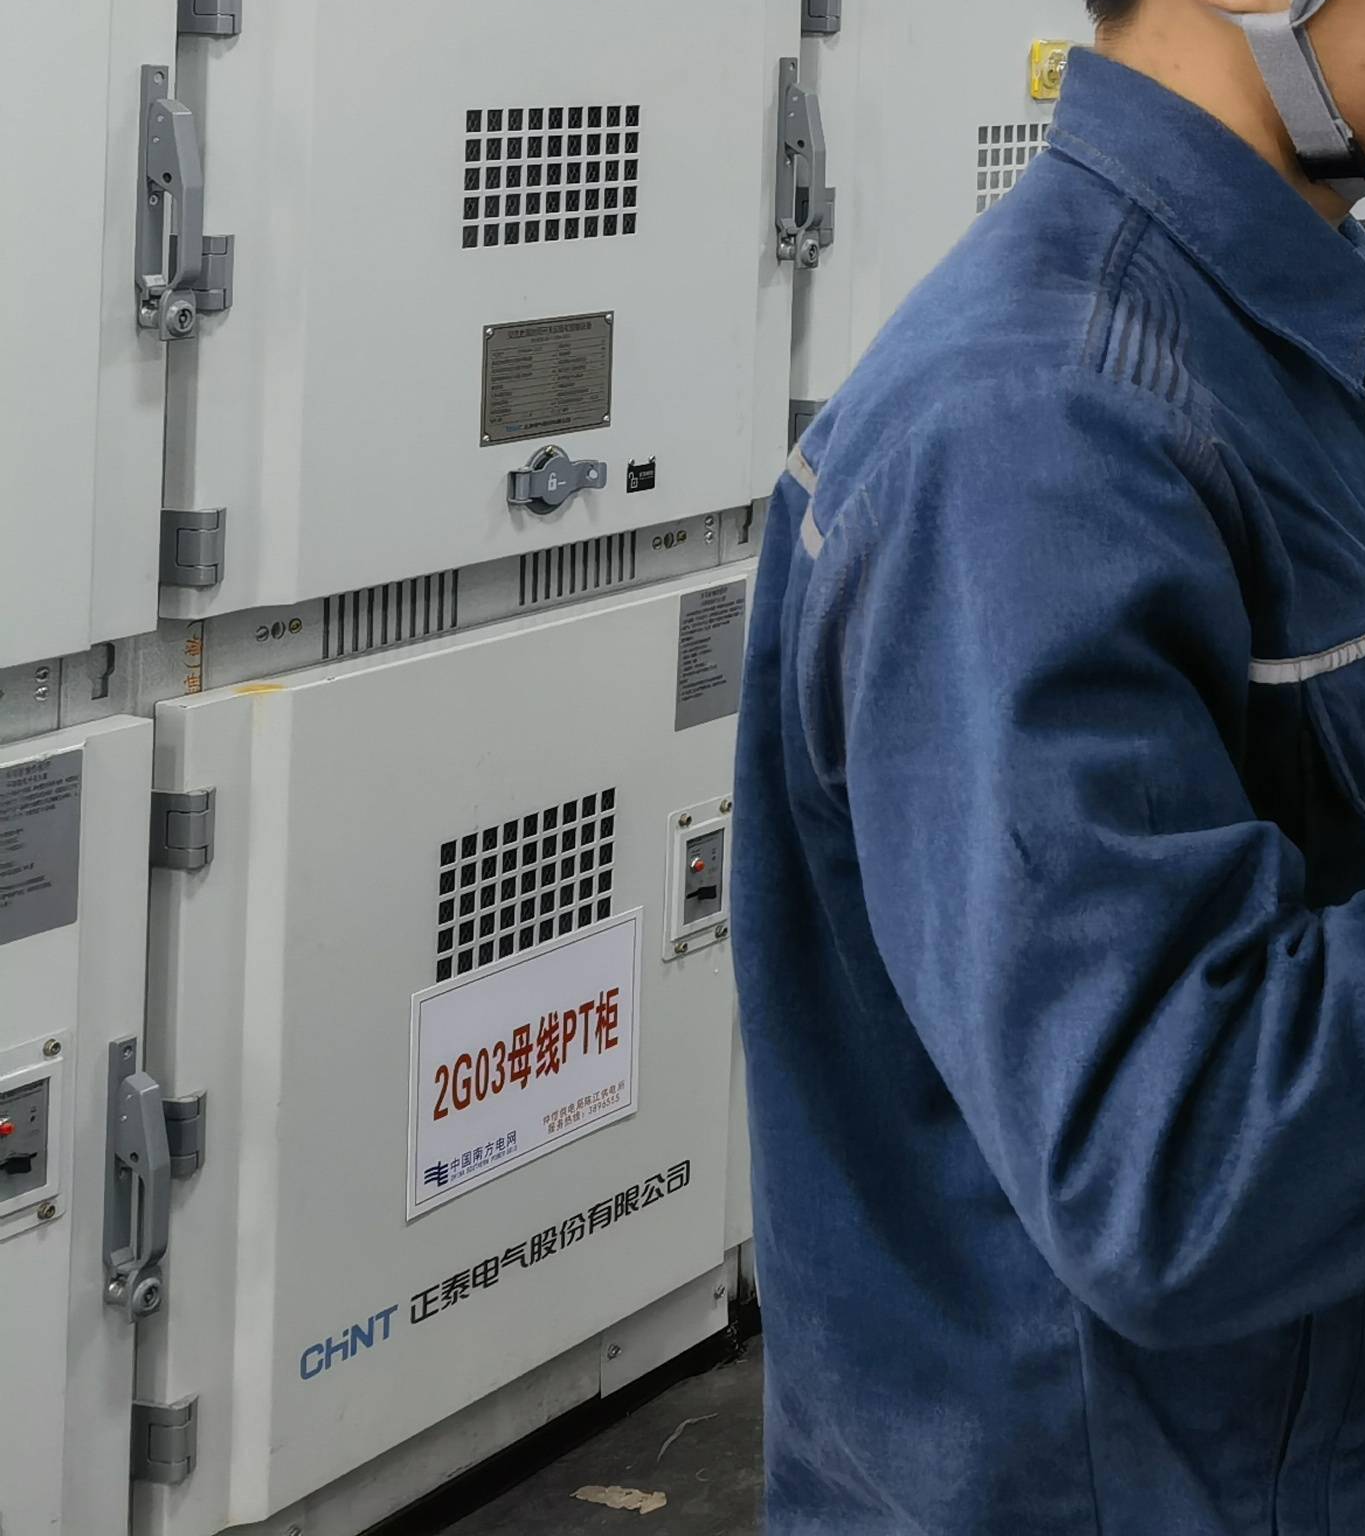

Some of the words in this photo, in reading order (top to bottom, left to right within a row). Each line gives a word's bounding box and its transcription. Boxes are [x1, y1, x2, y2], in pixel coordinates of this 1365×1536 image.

[434, 988, 619, 1121] 2G03母线PT柜
[450, 1130, 516, 1172] 中国南方电网
[410, 1160, 691, 1324] 正泰电气股份有限公司
